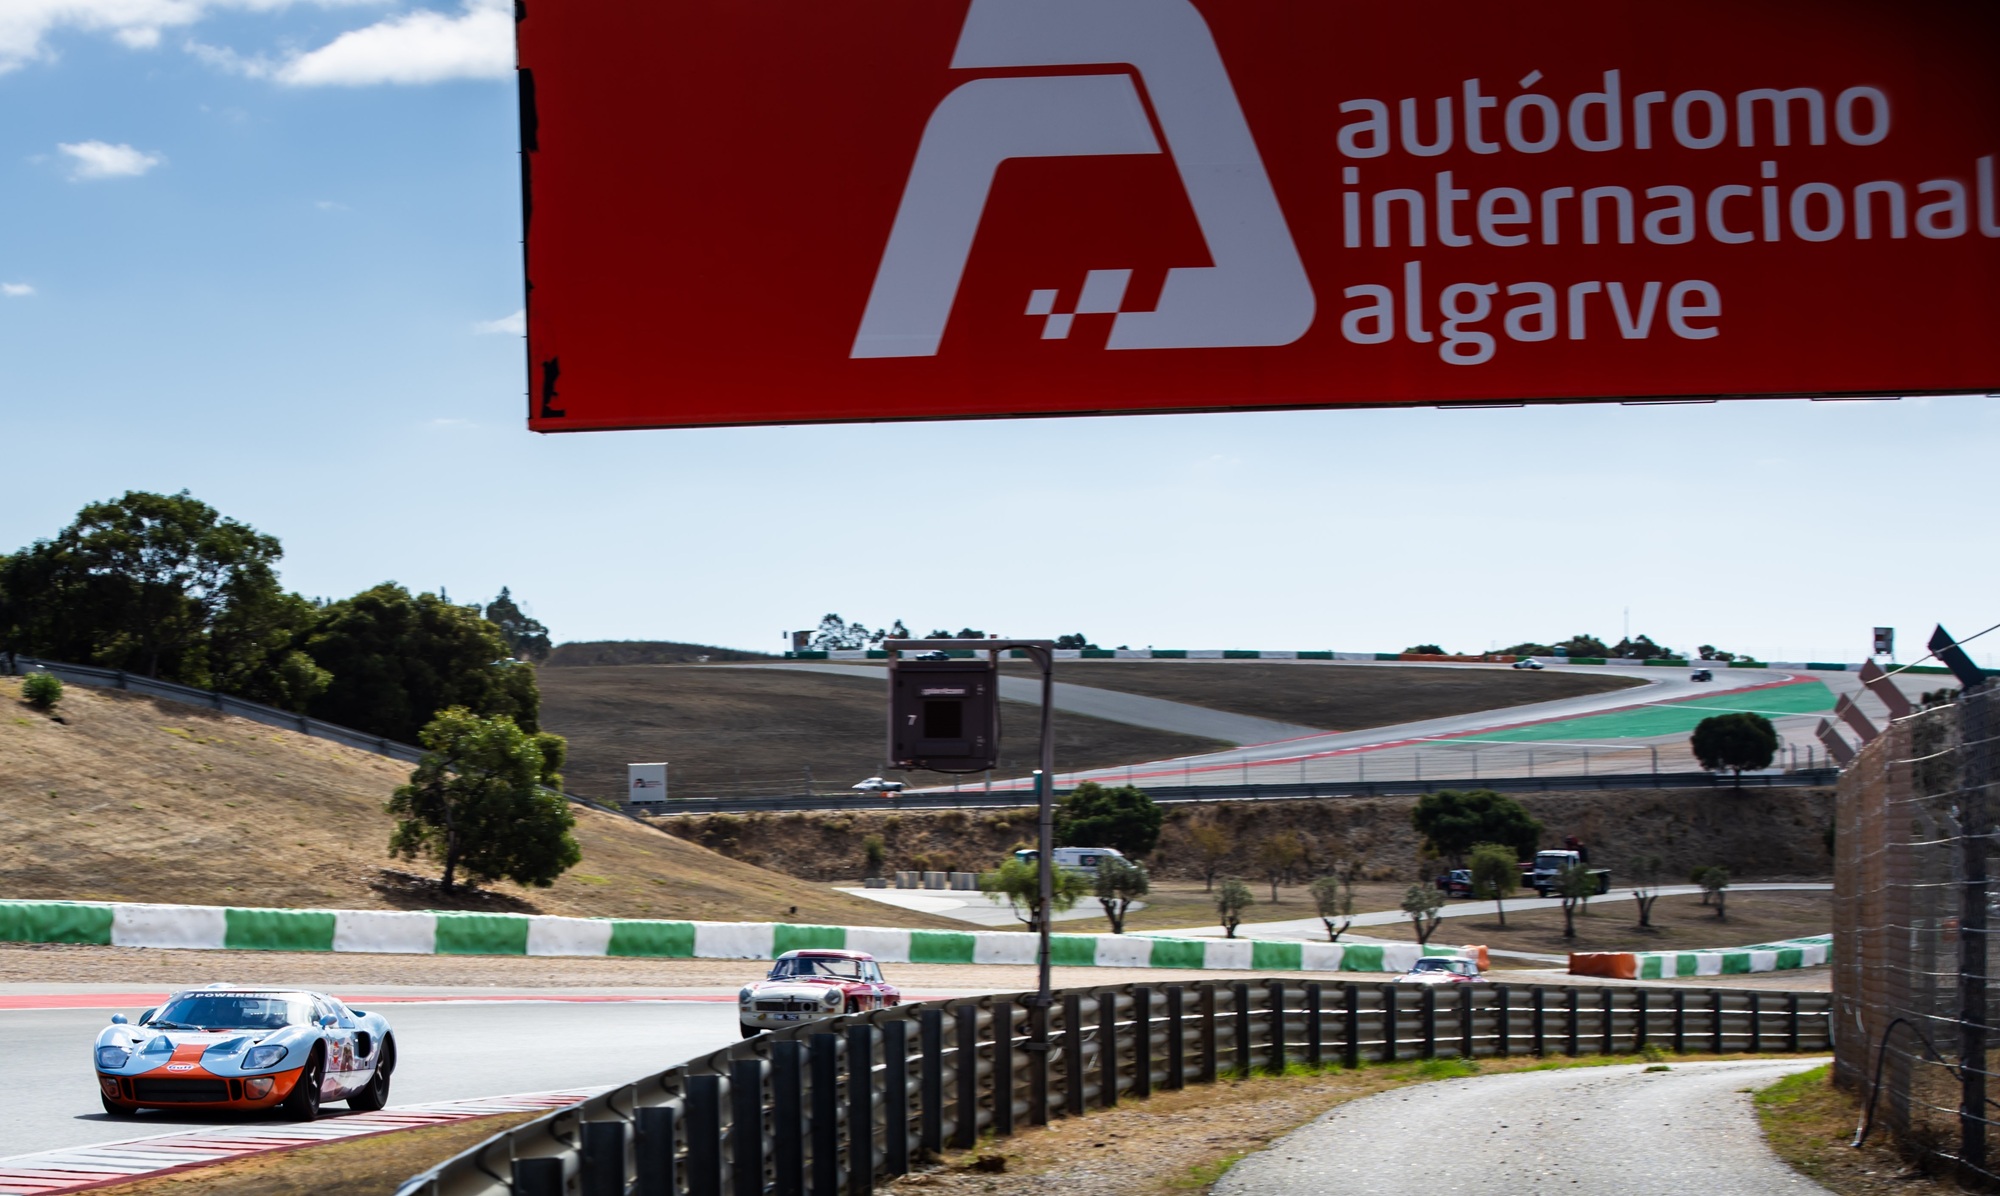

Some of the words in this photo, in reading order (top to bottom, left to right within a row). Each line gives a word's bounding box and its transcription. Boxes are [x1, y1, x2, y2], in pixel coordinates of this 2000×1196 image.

[1337, 69, 1890, 159] autódromo
[1342, 156, 2000, 248] internacional
[1340, 260, 1722, 366] algarve
[908, 714, 918, 725] 7
